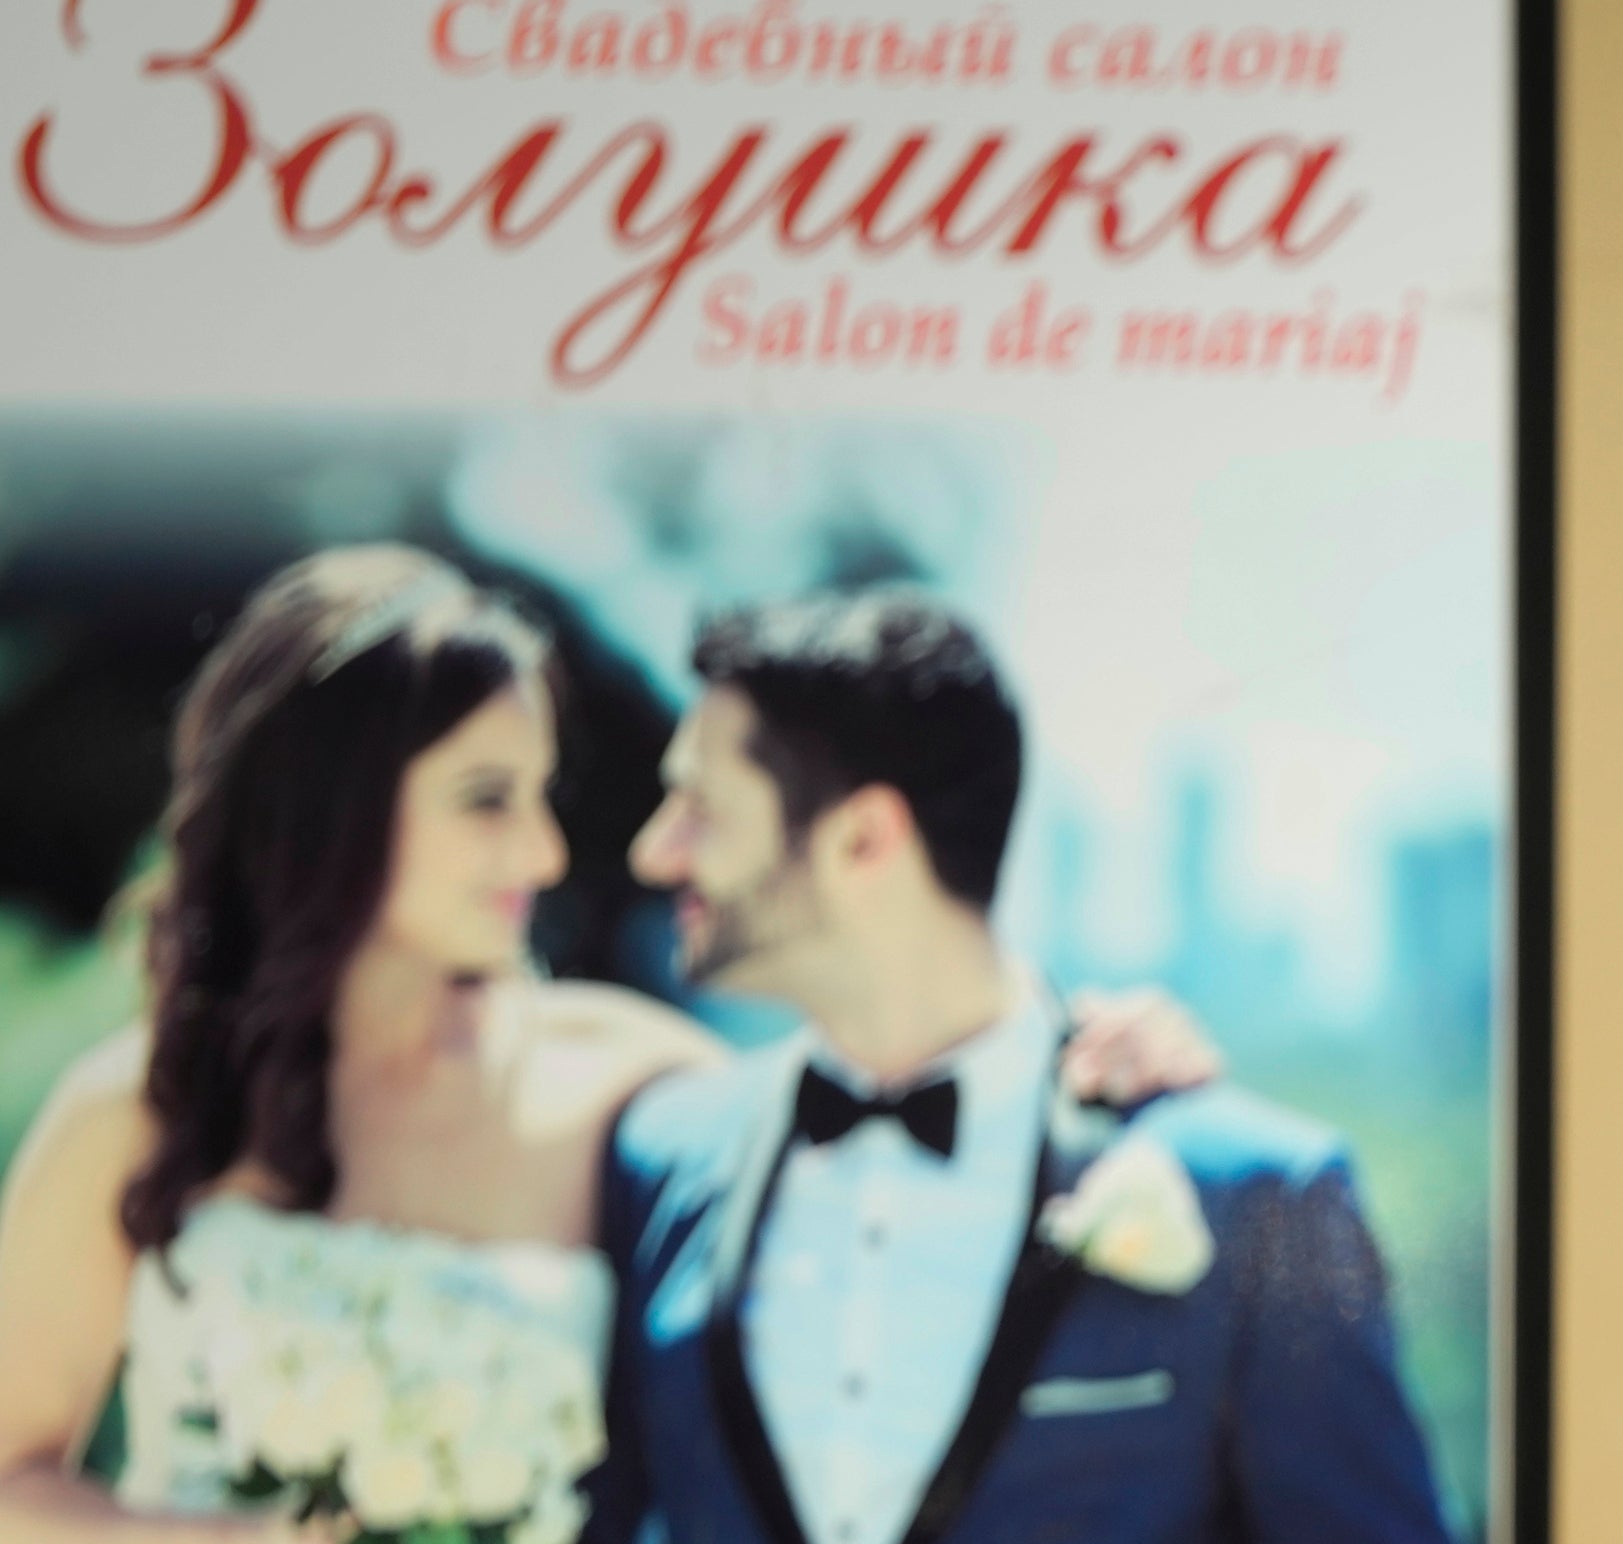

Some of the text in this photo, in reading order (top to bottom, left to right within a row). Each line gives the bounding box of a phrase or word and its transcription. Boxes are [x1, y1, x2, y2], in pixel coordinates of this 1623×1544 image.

[428, 0, 1340, 94] Свадебный салон
[16, 0, 1369, 388] Золушка
[698, 276, 1420, 405] Salon de mariaj
